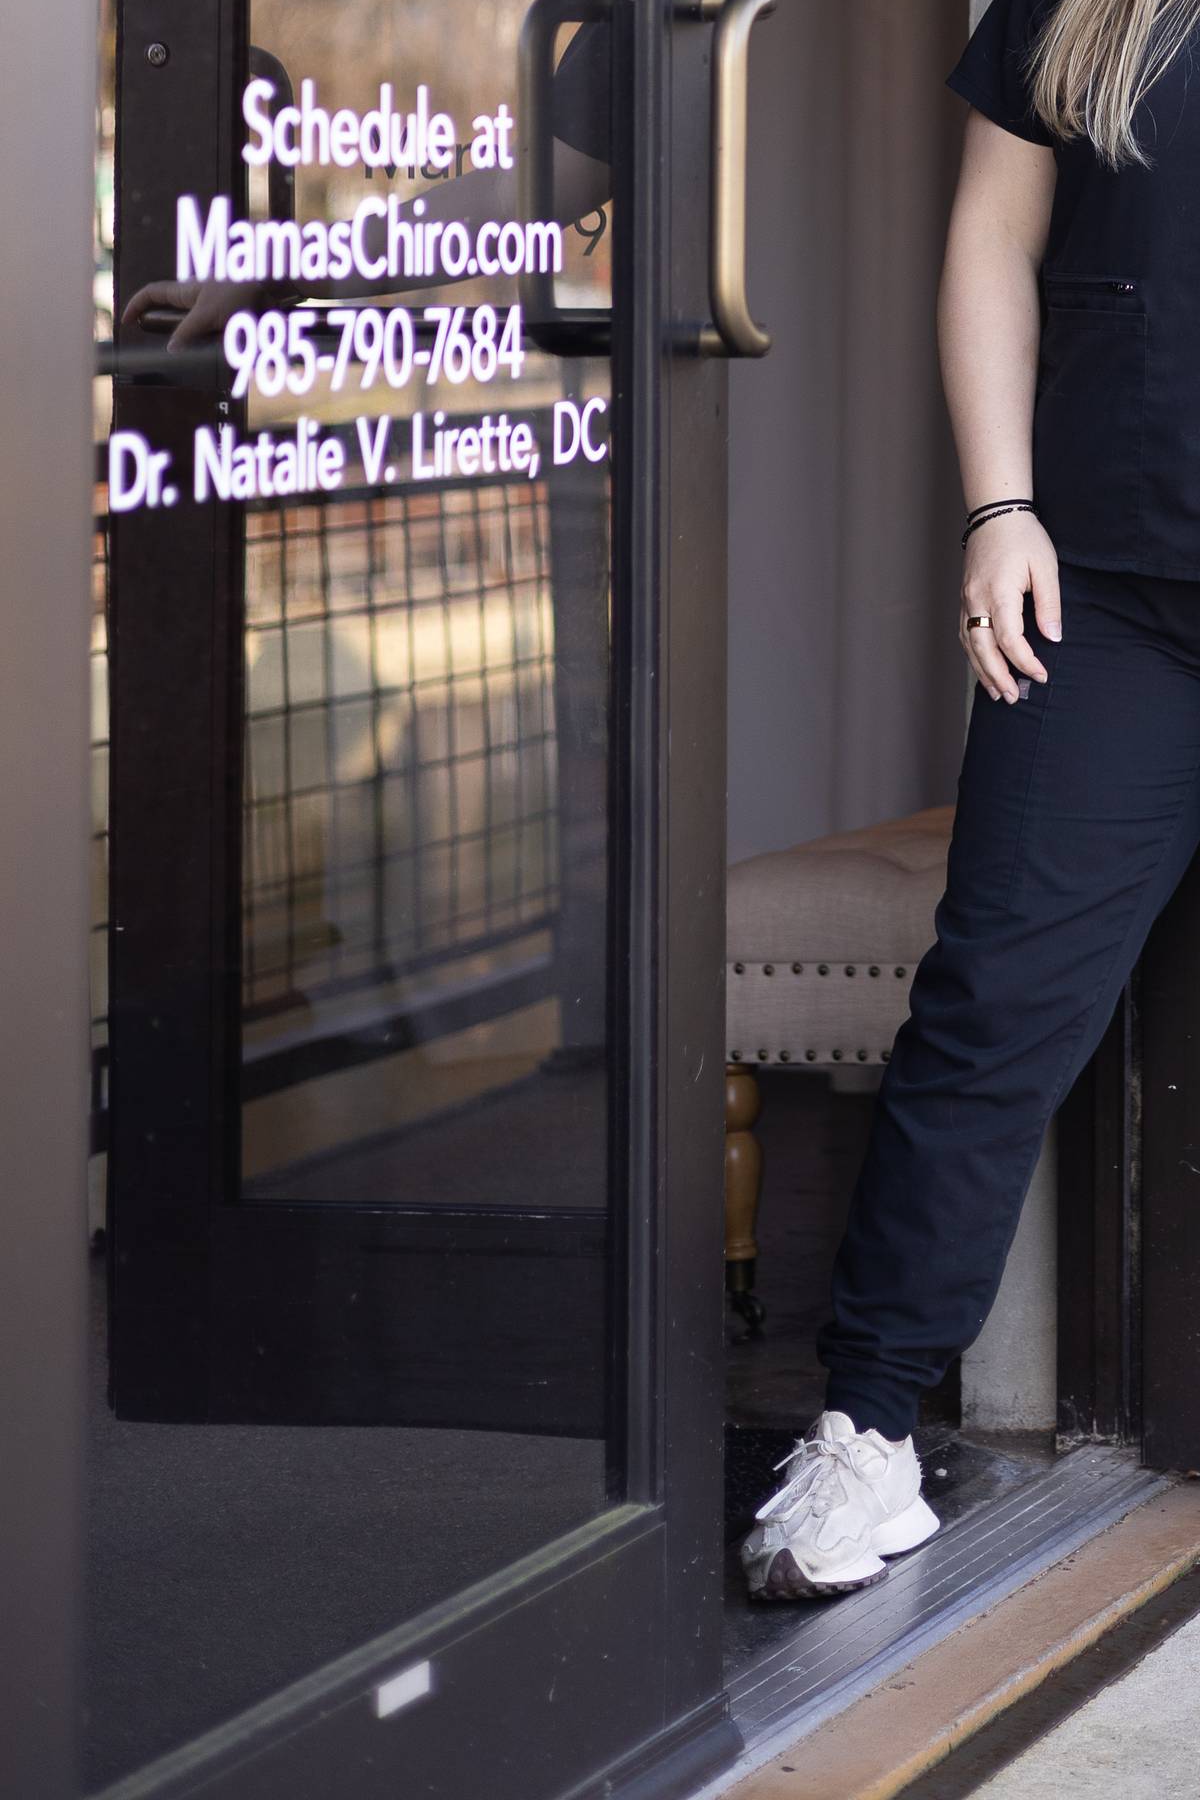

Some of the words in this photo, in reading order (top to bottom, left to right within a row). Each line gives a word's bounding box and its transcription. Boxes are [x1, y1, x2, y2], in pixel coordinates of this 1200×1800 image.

[242, 77, 455, 168] Schedule
[470, 103, 513, 170] at
[176, 193, 563, 283] MamasChiro.com
[223, 304, 523, 399] 985-790-7684
[109, 429, 177, 511] Dr.
[194, 416, 343, 502] Natalie
[356, 414, 395, 482] V.
[412, 409, 539, 479] Lirette,
[553, 397, 607, 466] DC
